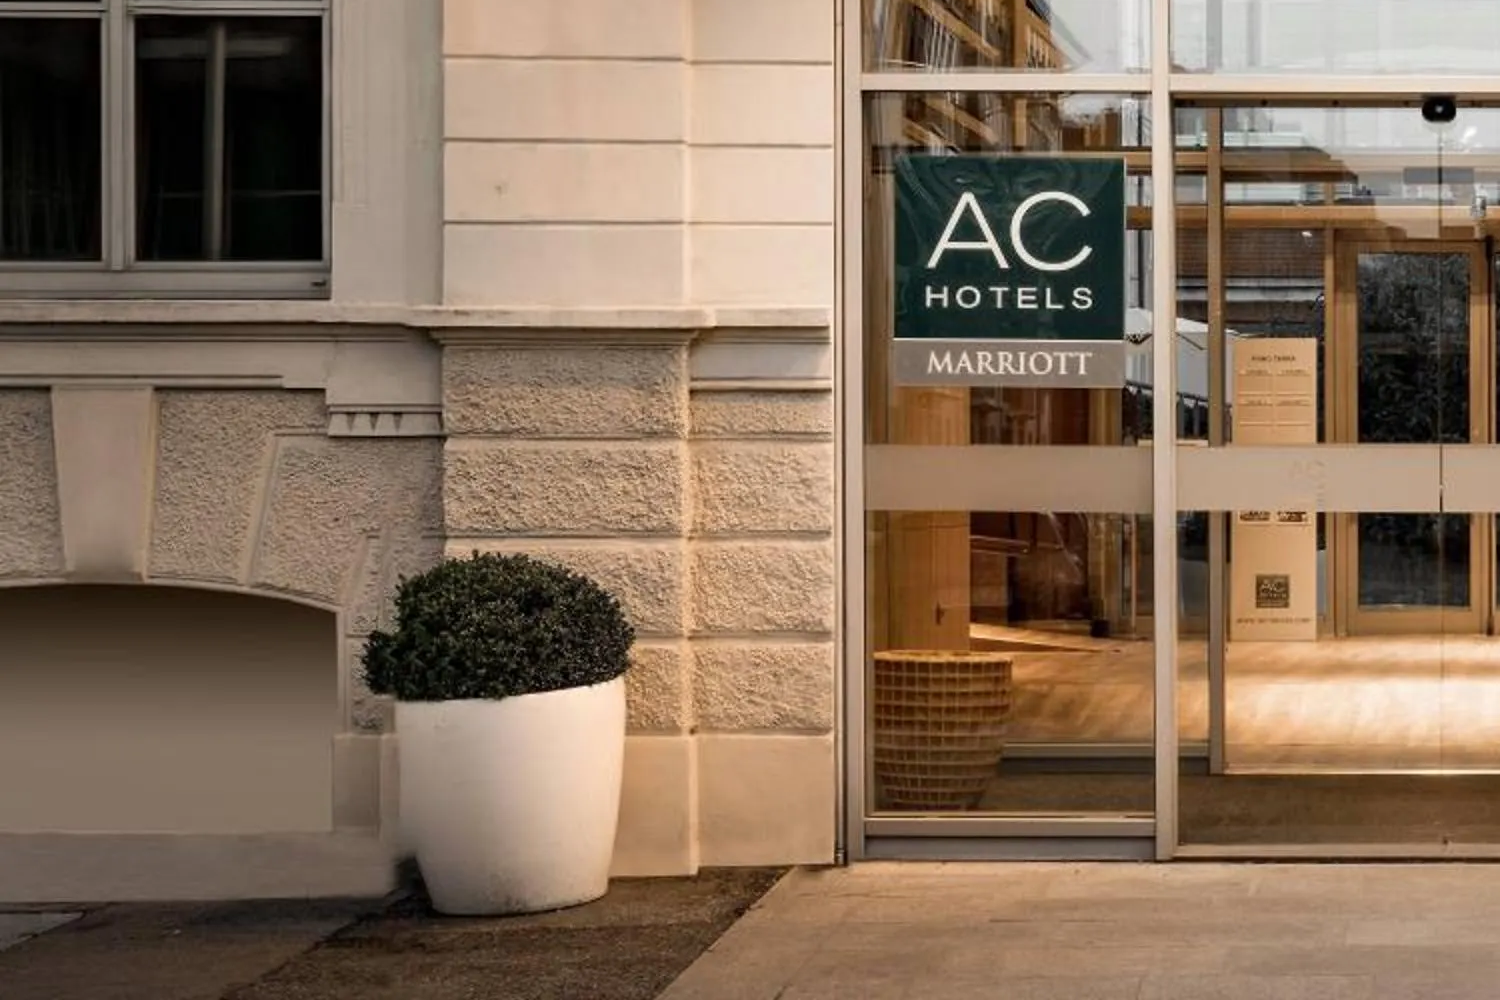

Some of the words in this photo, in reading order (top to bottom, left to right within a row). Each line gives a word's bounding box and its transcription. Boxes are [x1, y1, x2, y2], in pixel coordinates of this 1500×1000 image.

[926, 191, 1093, 271] AC
[925, 285, 1093, 309] HOTELS
[927, 351, 1094, 375] MARRIOTT
